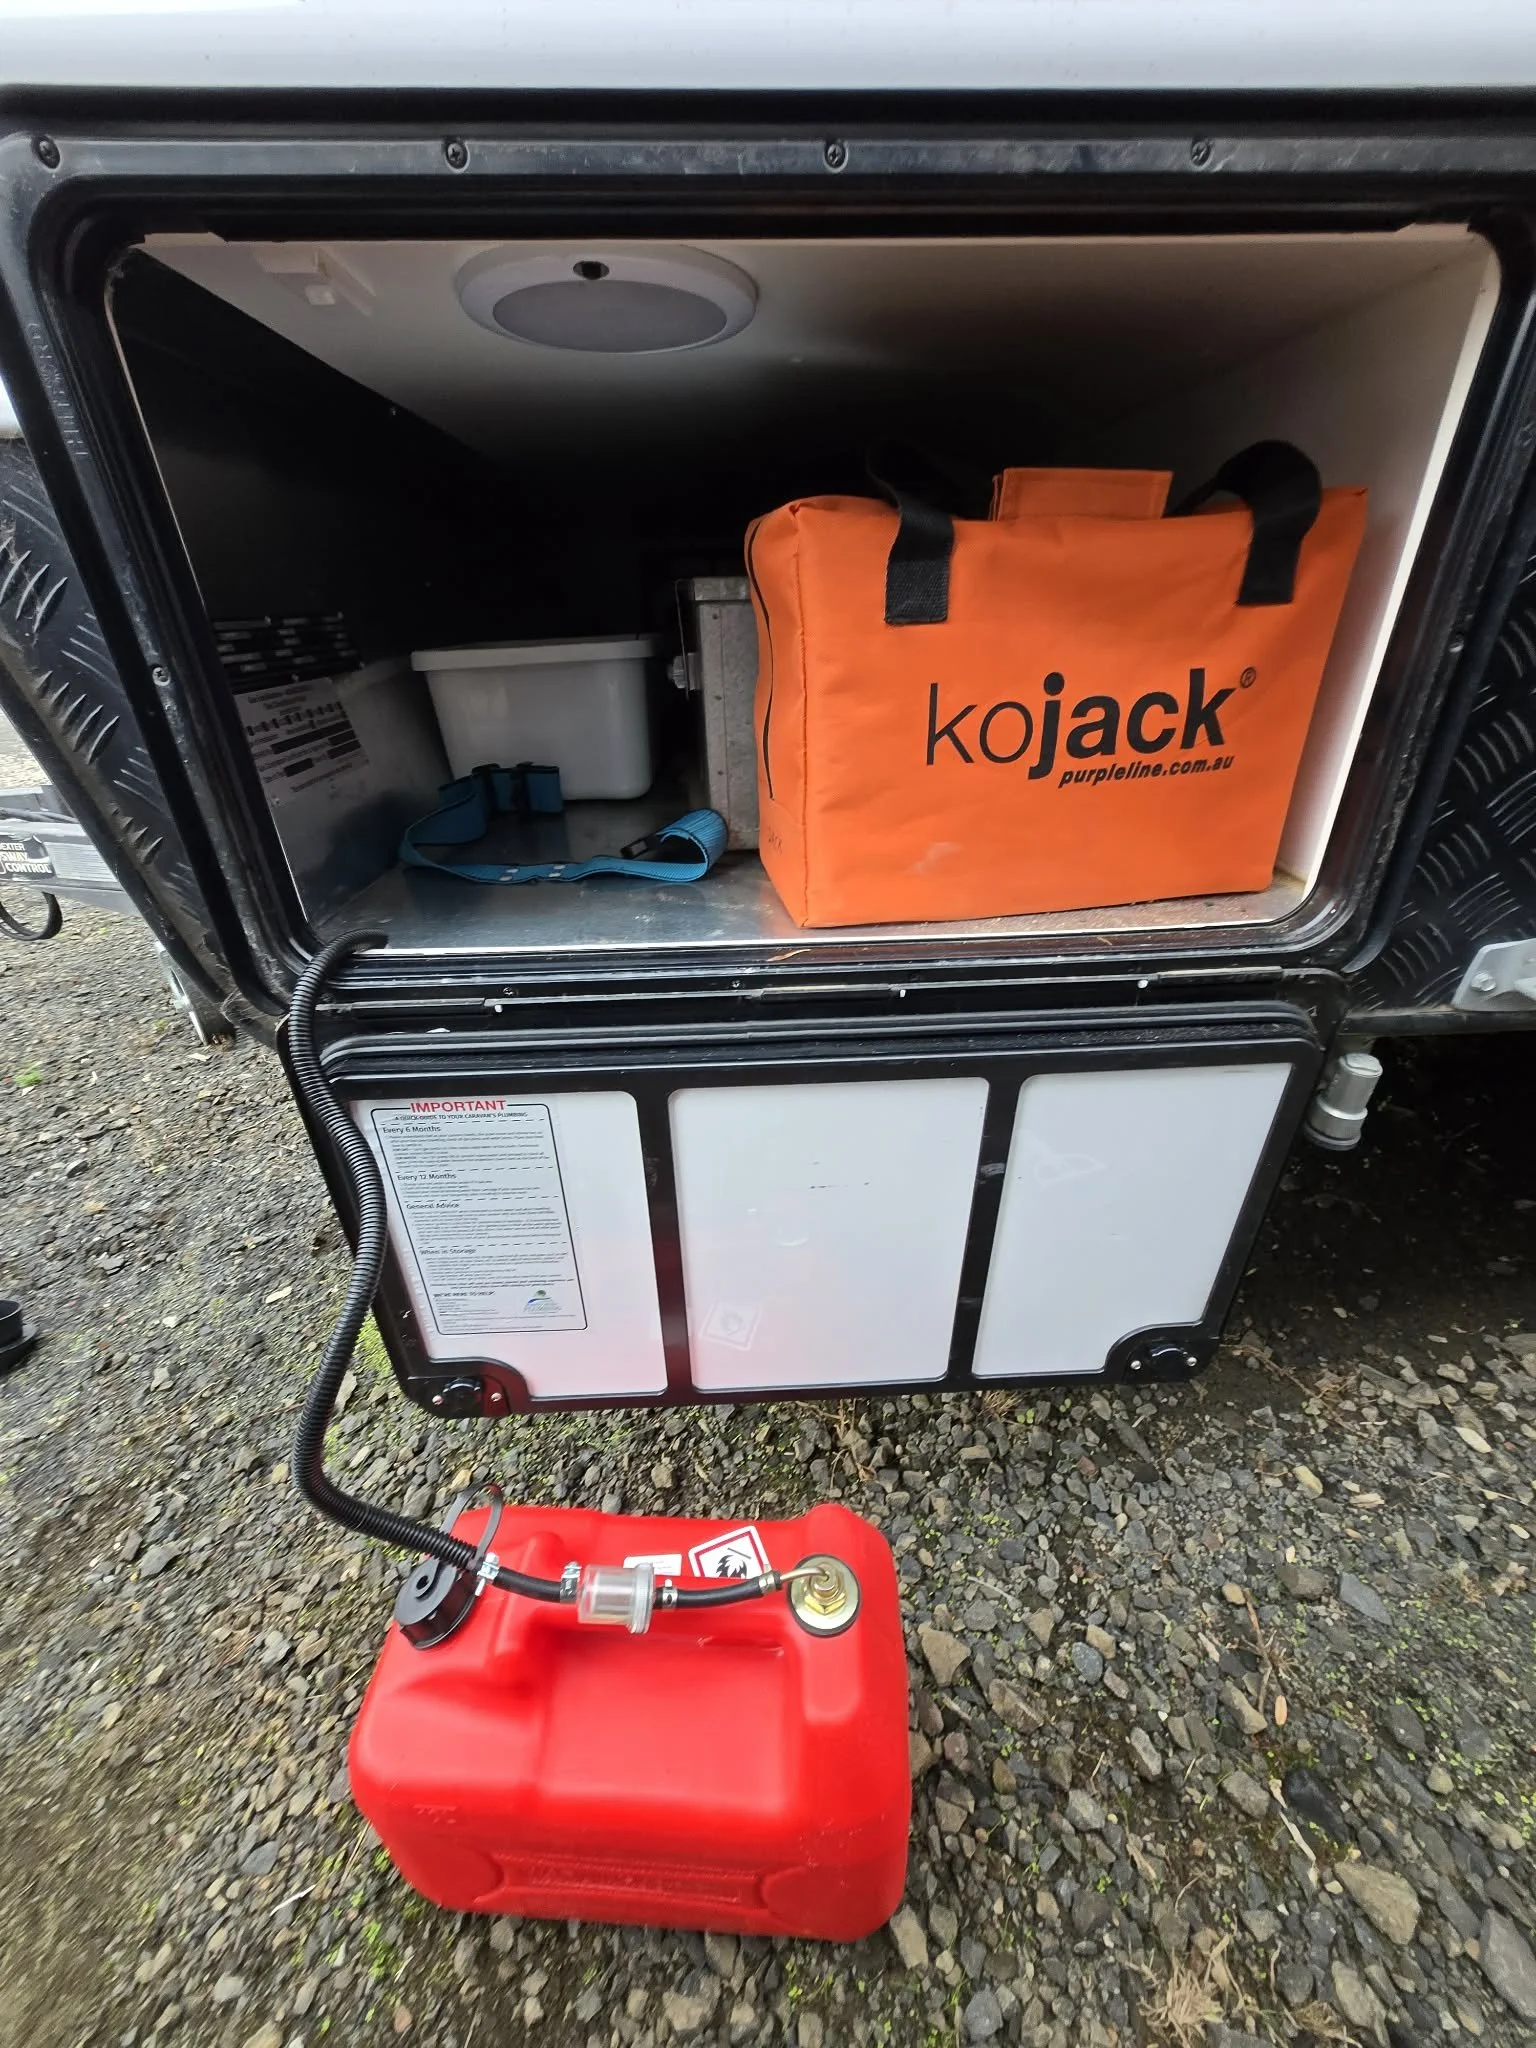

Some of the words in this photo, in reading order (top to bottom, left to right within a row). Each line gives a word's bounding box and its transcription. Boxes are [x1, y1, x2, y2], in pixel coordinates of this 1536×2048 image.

[1058, 755, 1236, 788] purpleline.com.au
[5, 862, 53, 874] CONTROL
[411, 1100, 506, 1113] IMPORTANT
[383, 1127, 404, 1135] Every
[413, 1125, 441, 1133] Months
[397, 1174, 417, 1182] Every
[429, 1172, 457, 1180] Months
